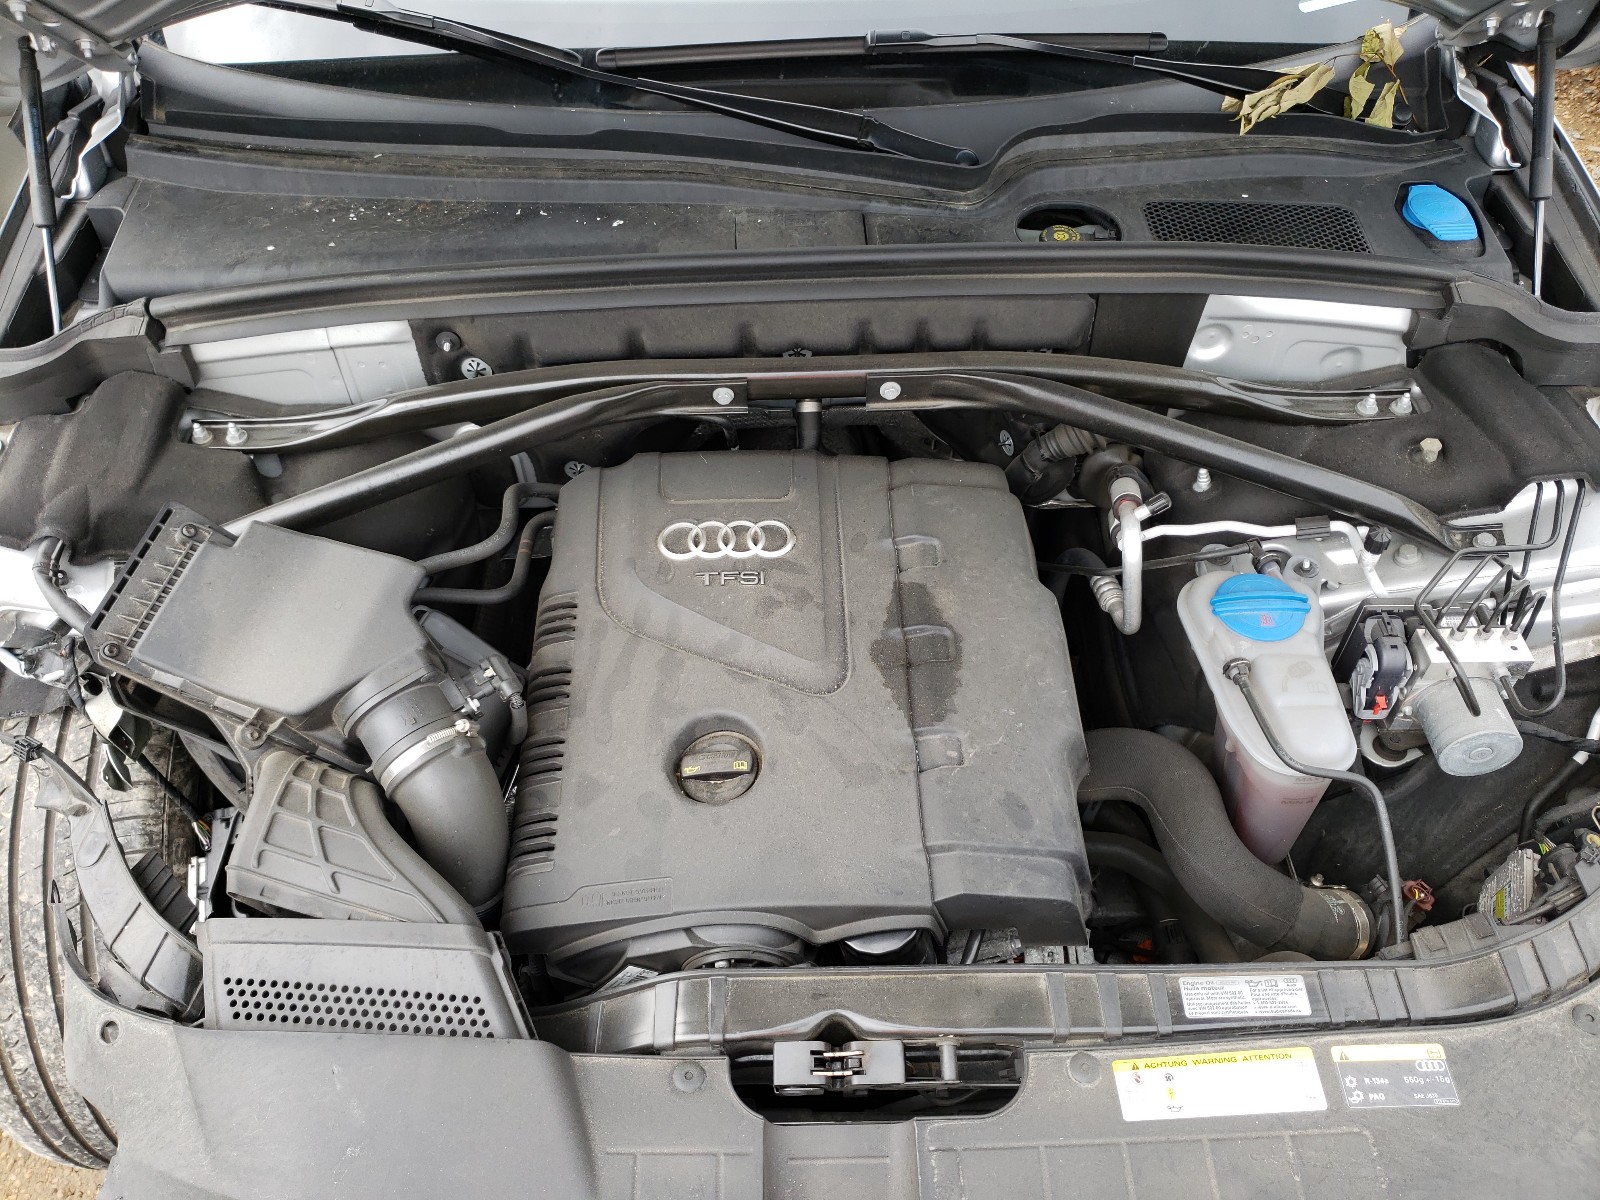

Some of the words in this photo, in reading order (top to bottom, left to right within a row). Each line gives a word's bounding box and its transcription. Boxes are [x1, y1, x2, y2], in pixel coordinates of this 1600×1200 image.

[695, 570, 766, 587] TFSI
[1144, 1060, 1188, 1069] ACHTUNG
[1192, 1056, 1238, 1065] WARNING
[1242, 1053, 1292, 1062] ATTENTION
